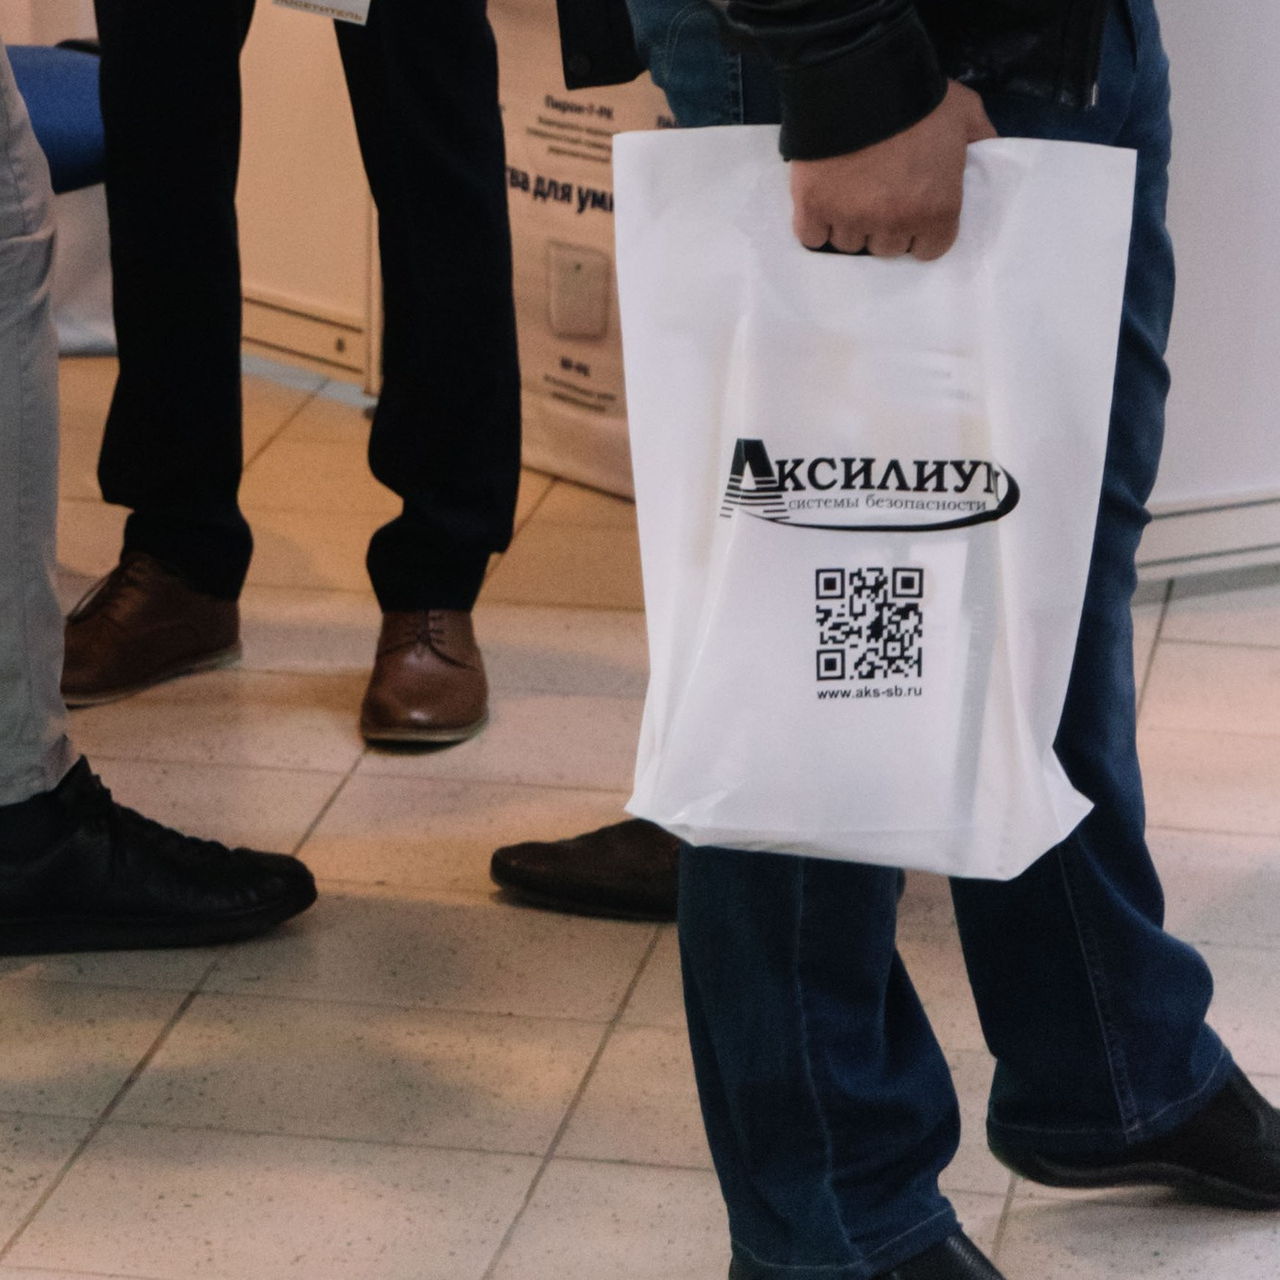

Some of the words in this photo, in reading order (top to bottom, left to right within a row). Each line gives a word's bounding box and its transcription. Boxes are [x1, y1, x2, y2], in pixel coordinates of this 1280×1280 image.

[533, 174, 572, 204] для
[788, 495, 860, 511] системы
[865, 492, 987, 513] безопасности
[817, 685, 923, 700] www.aks-sb.ru
